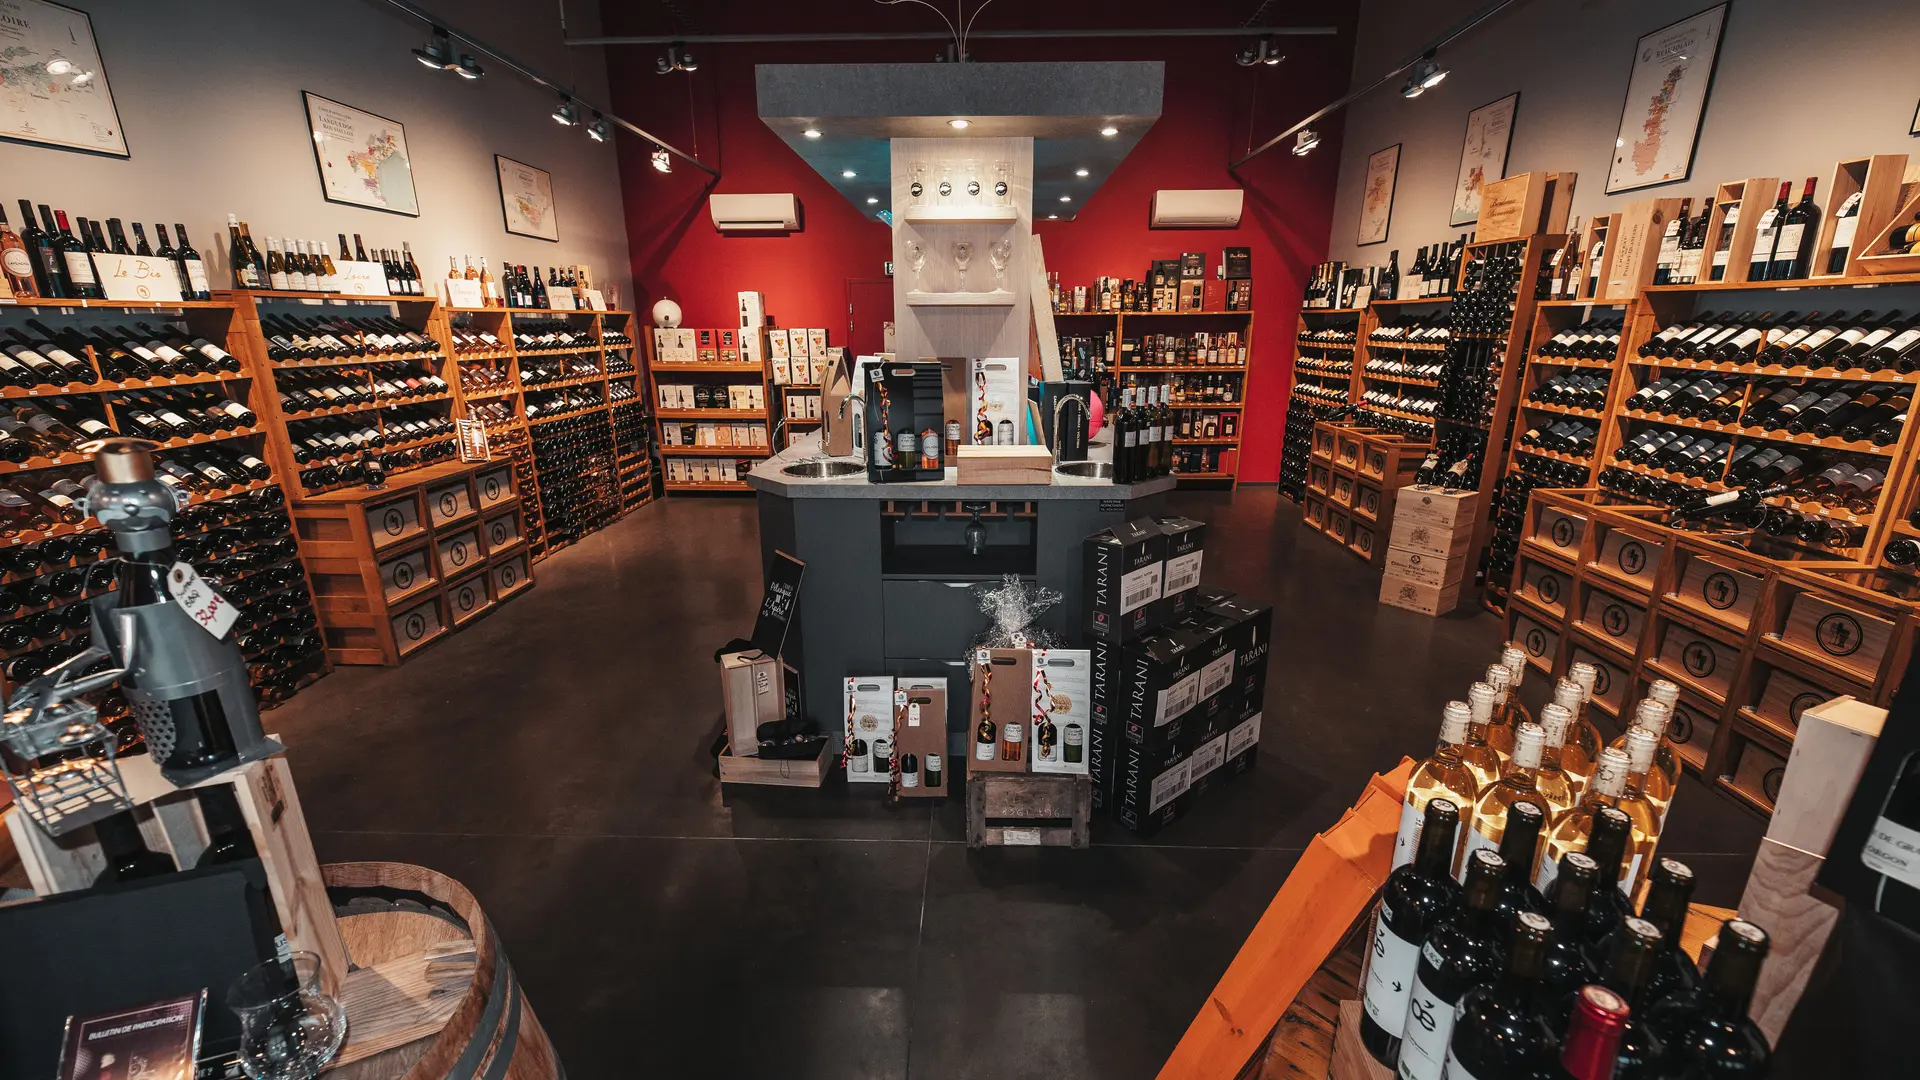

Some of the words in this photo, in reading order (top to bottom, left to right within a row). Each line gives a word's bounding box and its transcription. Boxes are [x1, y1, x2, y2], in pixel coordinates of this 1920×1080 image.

[113, 259, 128, 278] Le
[133, 259, 162, 279] Bio
[343, 266, 370, 281] Loire
[1133, 553, 1153, 566] TARANI
[1096, 546, 1109, 606] TARANI
[1240, 642, 1268, 666] TARANI
[1095, 641, 1108, 700] TARANI
[1130, 659, 1149, 719] TARANI
[1092, 728, 1103, 784] TARANI
[1125, 748, 1140, 805] TARANI
[1864, 844, 1908, 867] ORGON
[88, 1027, 122, 1041] BULLETIN
[121, 1024, 133, 1035] DE
[132, 1014, 186, 1032] PARTICIPATION
